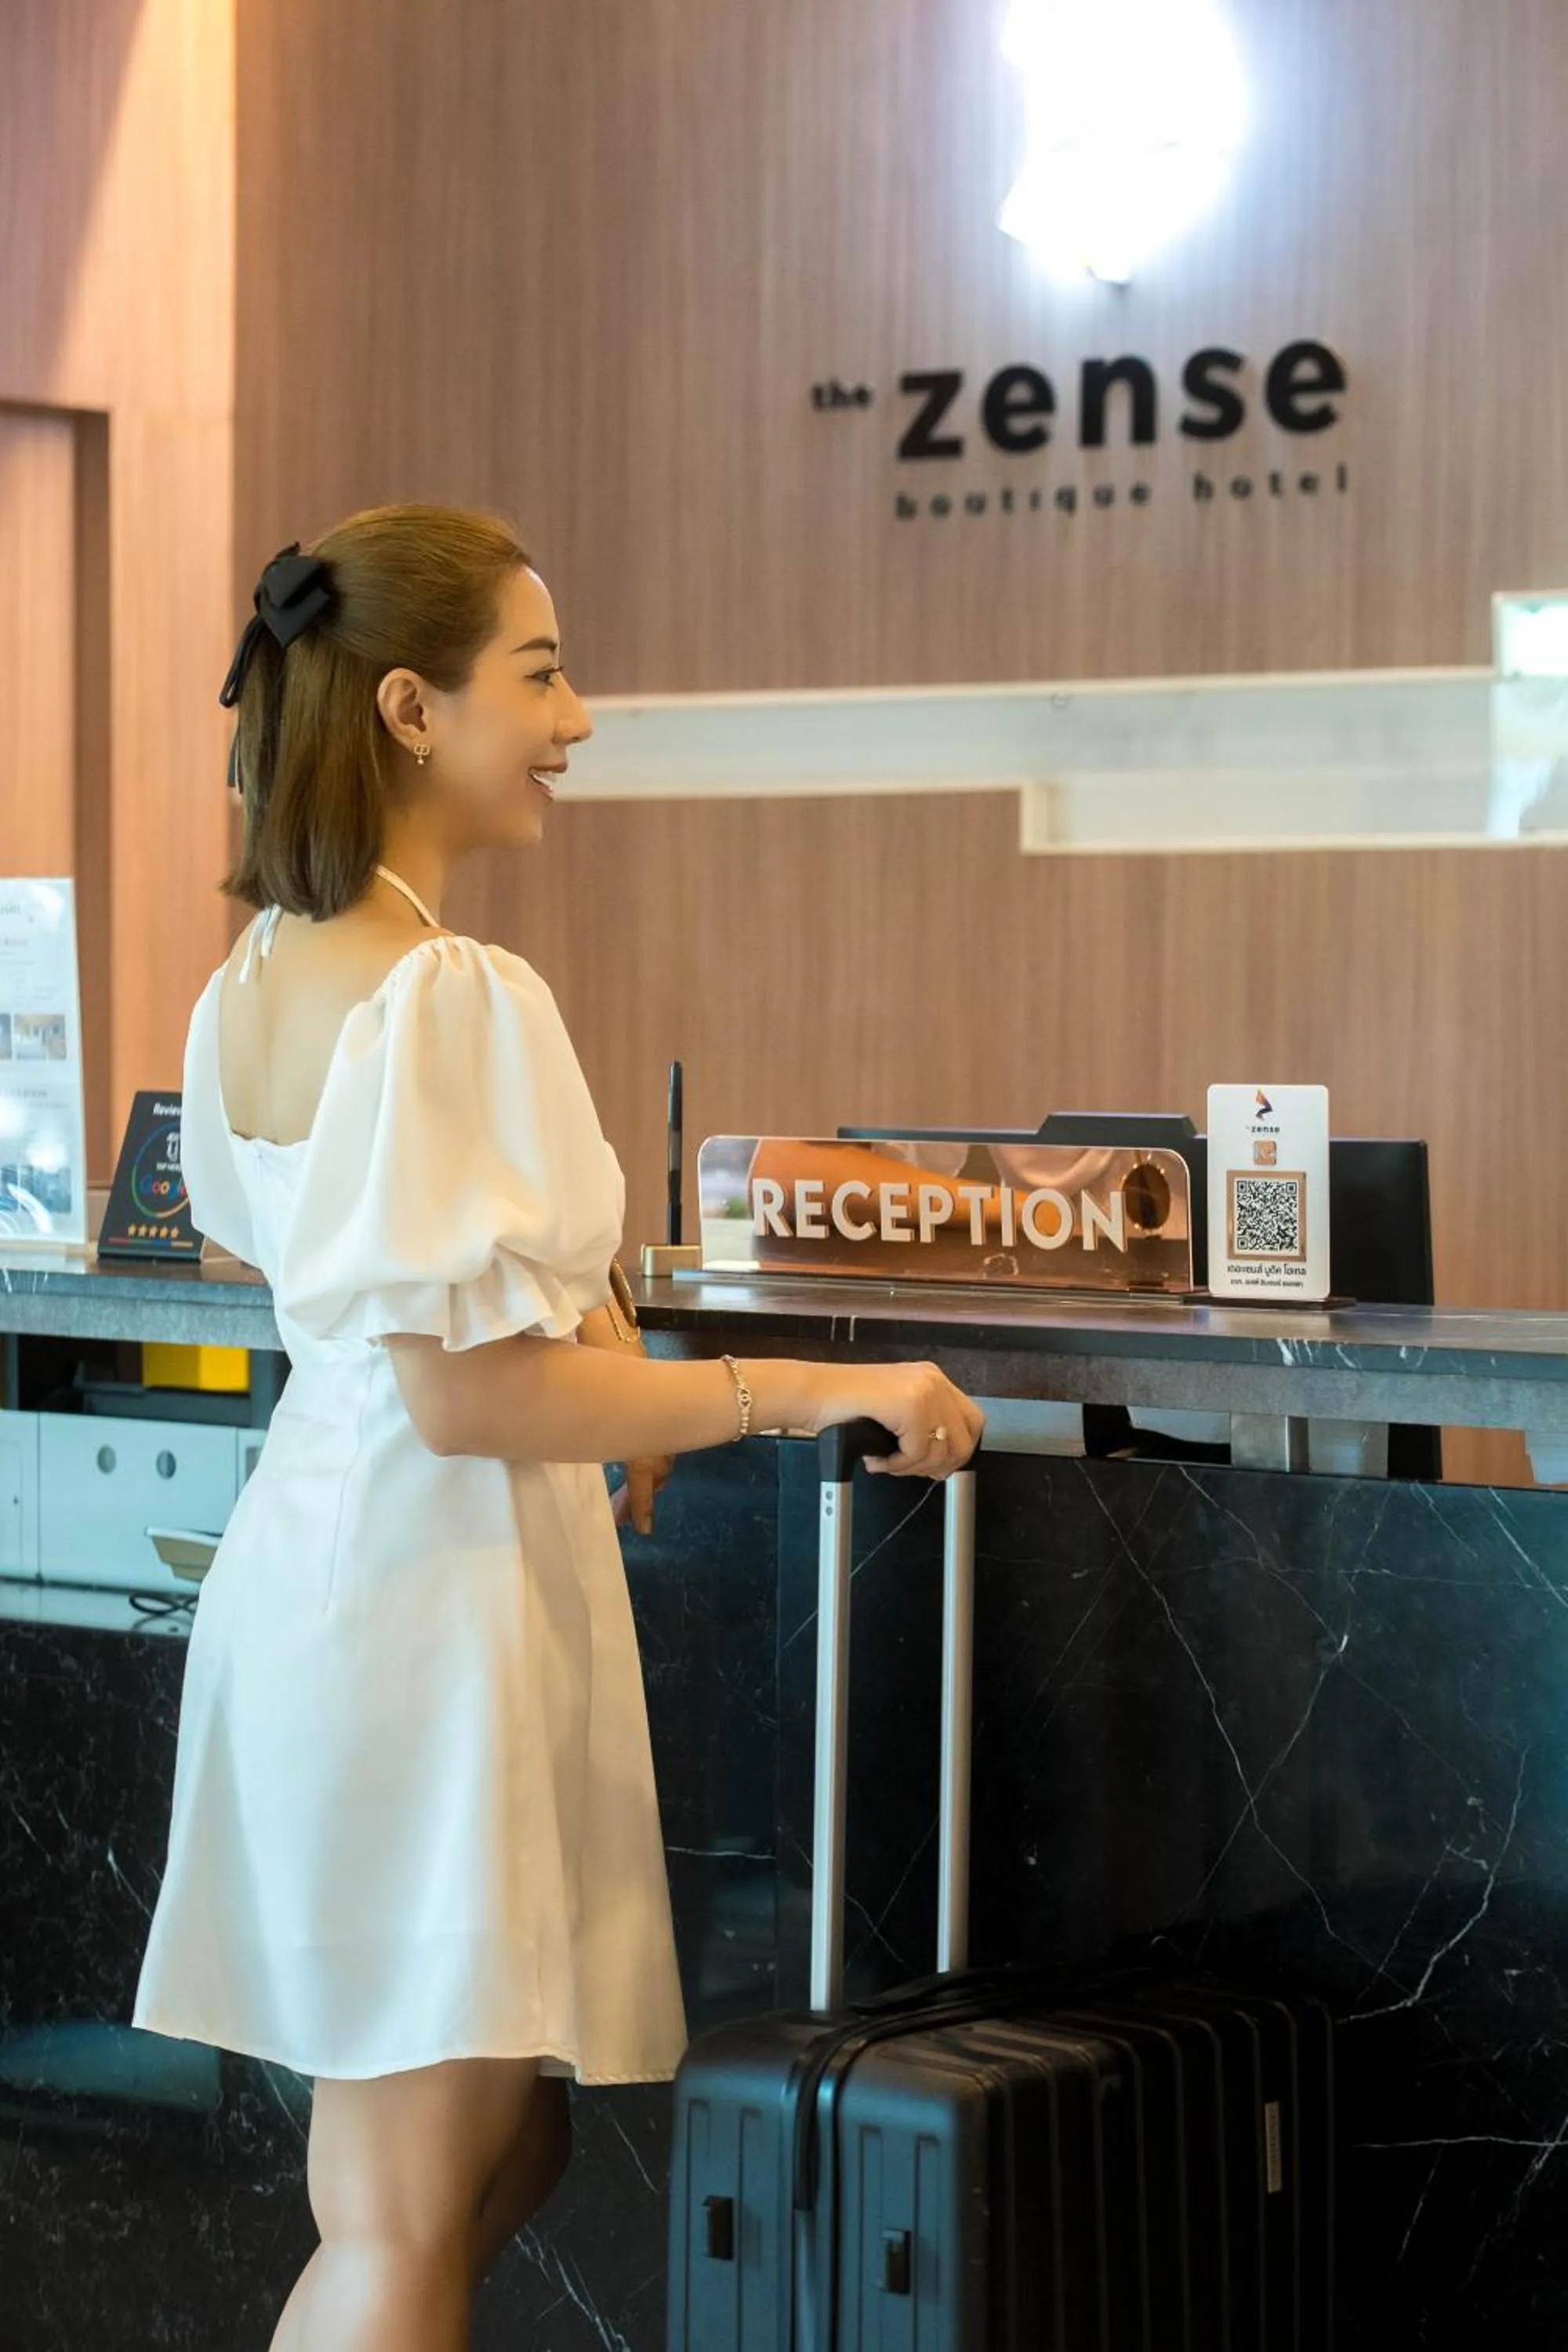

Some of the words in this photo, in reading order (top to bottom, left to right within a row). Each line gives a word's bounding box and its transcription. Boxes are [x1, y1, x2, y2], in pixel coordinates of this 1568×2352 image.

[812, 377, 873, 412] the
[898, 340, 1347, 460] zense
[895, 481, 1152, 521] boutique
[1192, 462, 1347, 503] hotel
[751, 1178, 1127, 1252] RECEPTION
